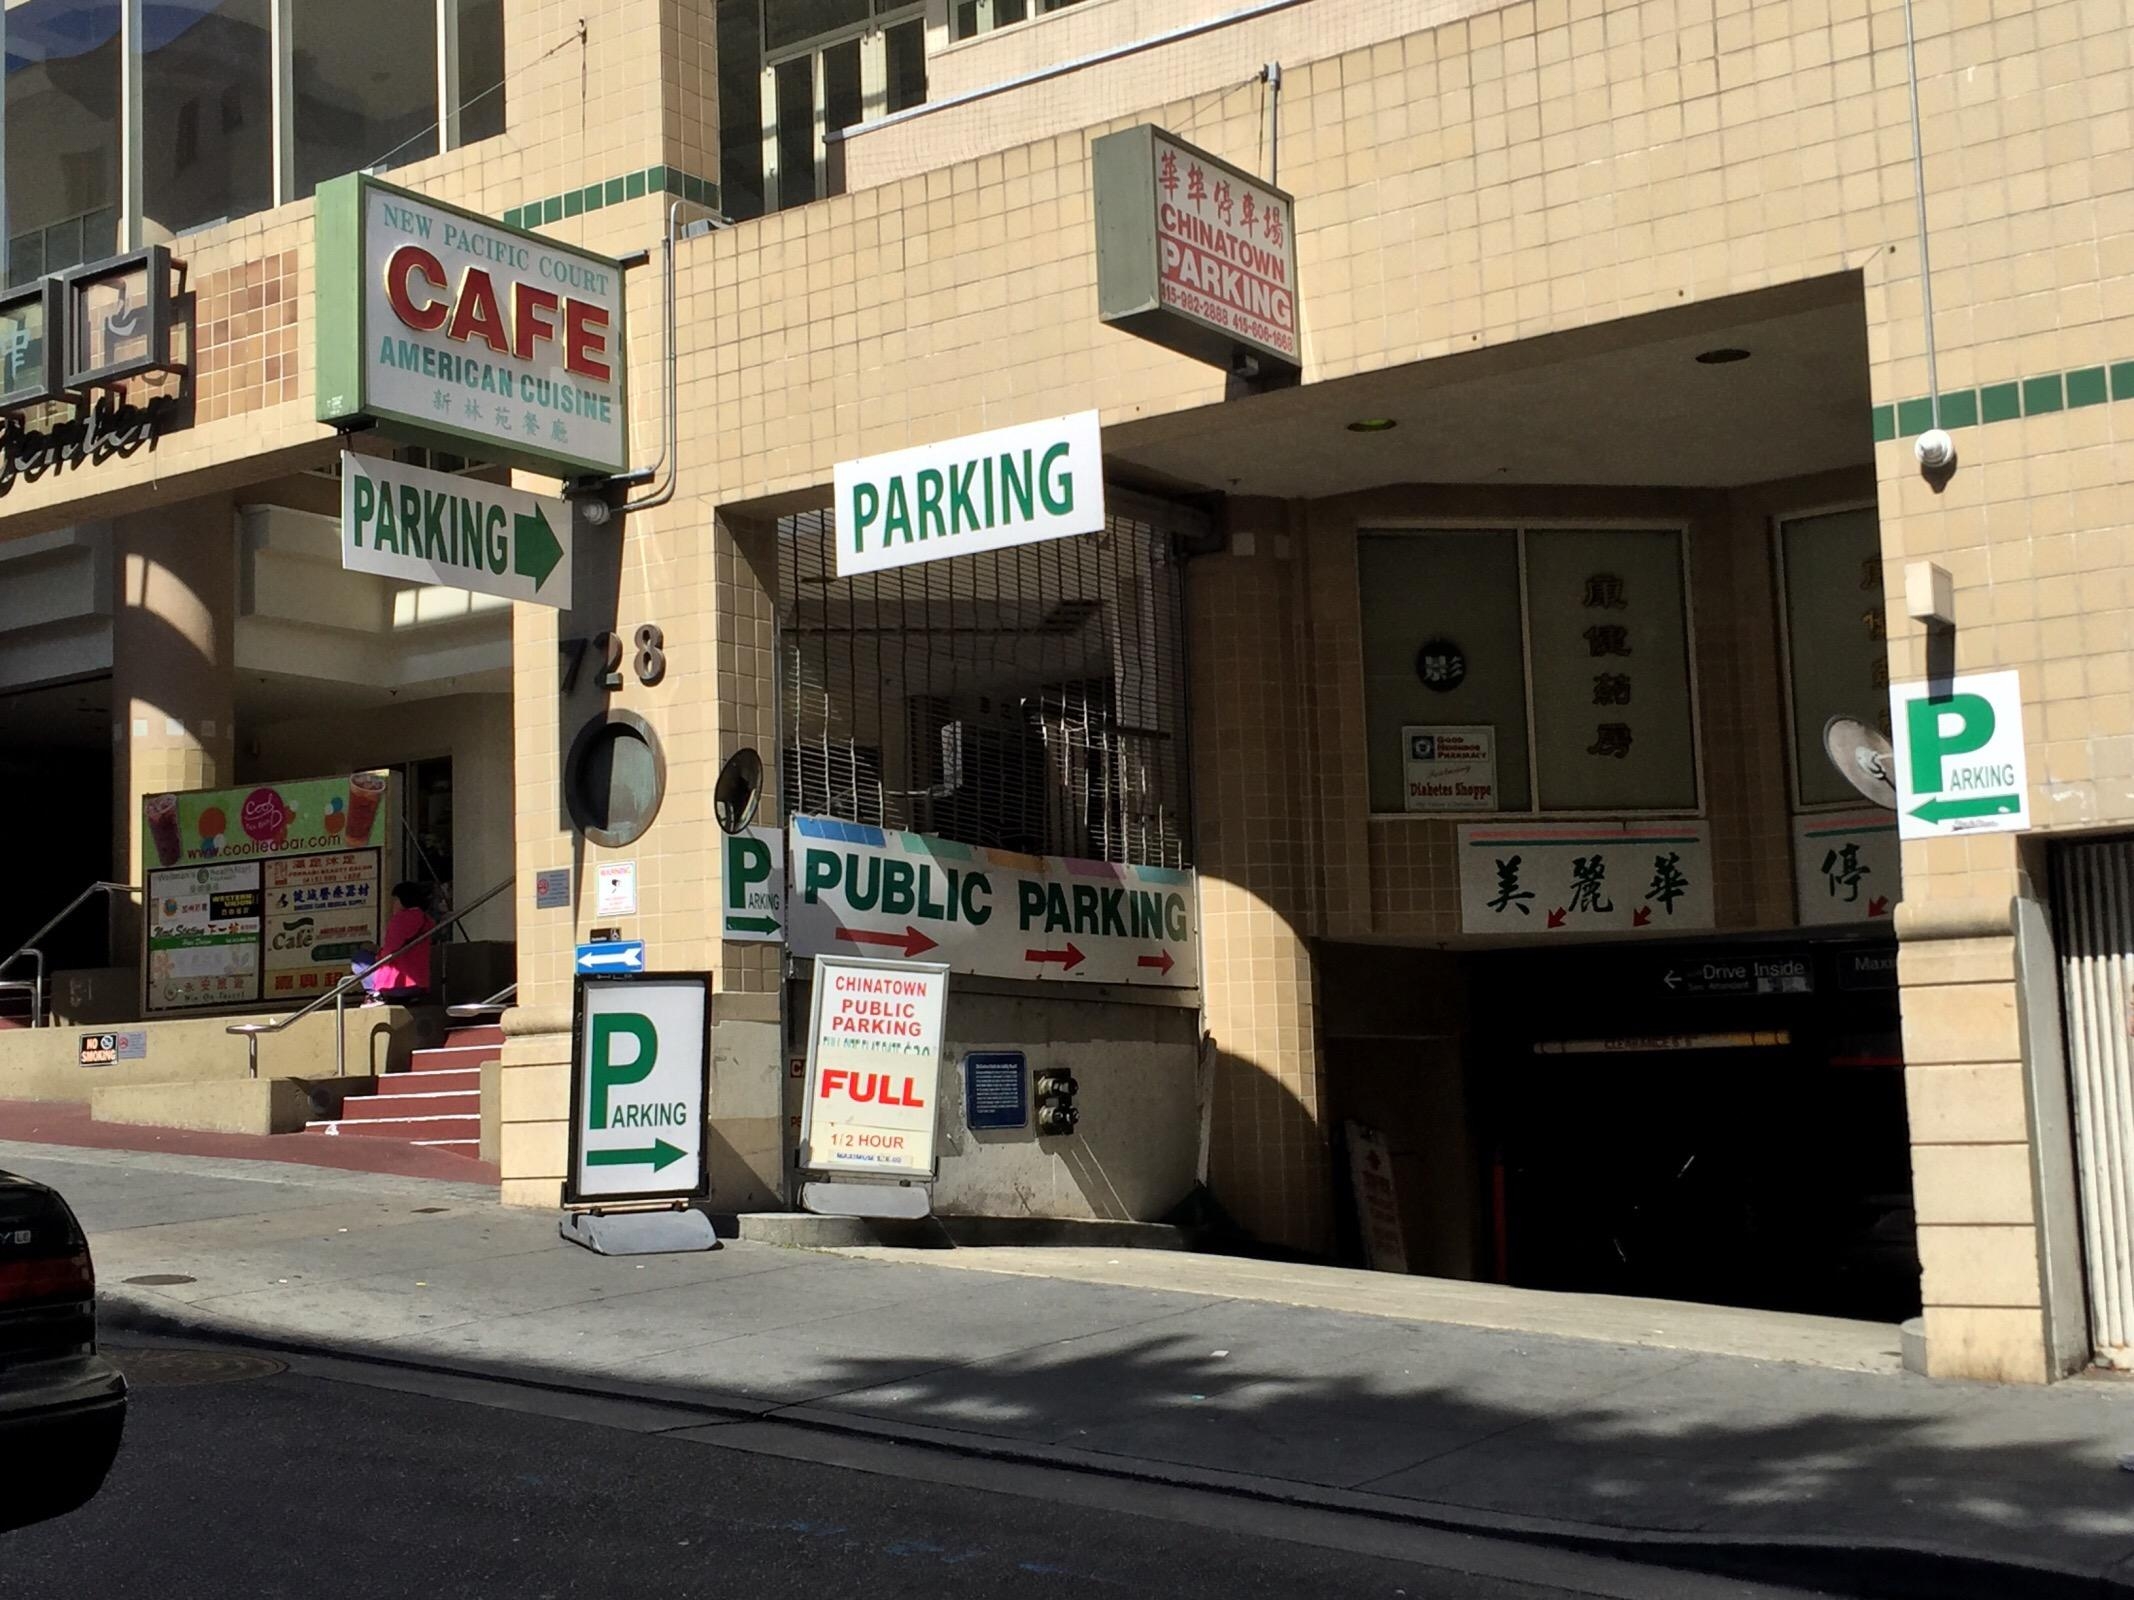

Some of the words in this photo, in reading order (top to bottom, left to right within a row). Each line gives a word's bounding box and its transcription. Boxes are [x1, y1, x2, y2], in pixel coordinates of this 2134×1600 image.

[384, 203, 433, 240] NEW
[444, 224, 530, 271] PACIFIC
[539, 256, 609, 296] COURT
[1161, 202, 1285, 284] CHINATOWN
[384, 244, 611, 384] CAFE
[1161, 239, 1291, 328] PARKING
[380, 336, 513, 398] AMERICAN
[521, 374, 612, 424] CUISINE
[354, 474, 508, 575] PARKING
[853, 441, 1075, 554] PARKING
[559, 624, 666, 694] 728
[1410, 782, 1452, 798] Diabetes
[1455, 782, 1491, 800] Shoppe
[728, 836, 780, 910] PARKING
[805, 848, 992, 925] PUBLIC
[1018, 880, 1188, 942] PARKING
[1487, 852, 1689, 916] 美麗華
[1820, 843, 1871, 902] 停
[835, 976, 926, 997] CHINATOWN
[1703, 964, 1747, 981] Drive
[1754, 960, 1805, 977] Inside
[832, 1017, 922, 1037] PARKING
[841, 999, 915, 1018] PUBLIC
[81, 1049, 116, 1062] SMOKING
[86, 1037, 98, 1050] NO
[589, 1013, 687, 1129] PARKING
[820, 1068, 924, 1108] FULL
[831, 1134, 853, 1147] 1/2
[858, 1134, 904, 1149] HOUR
